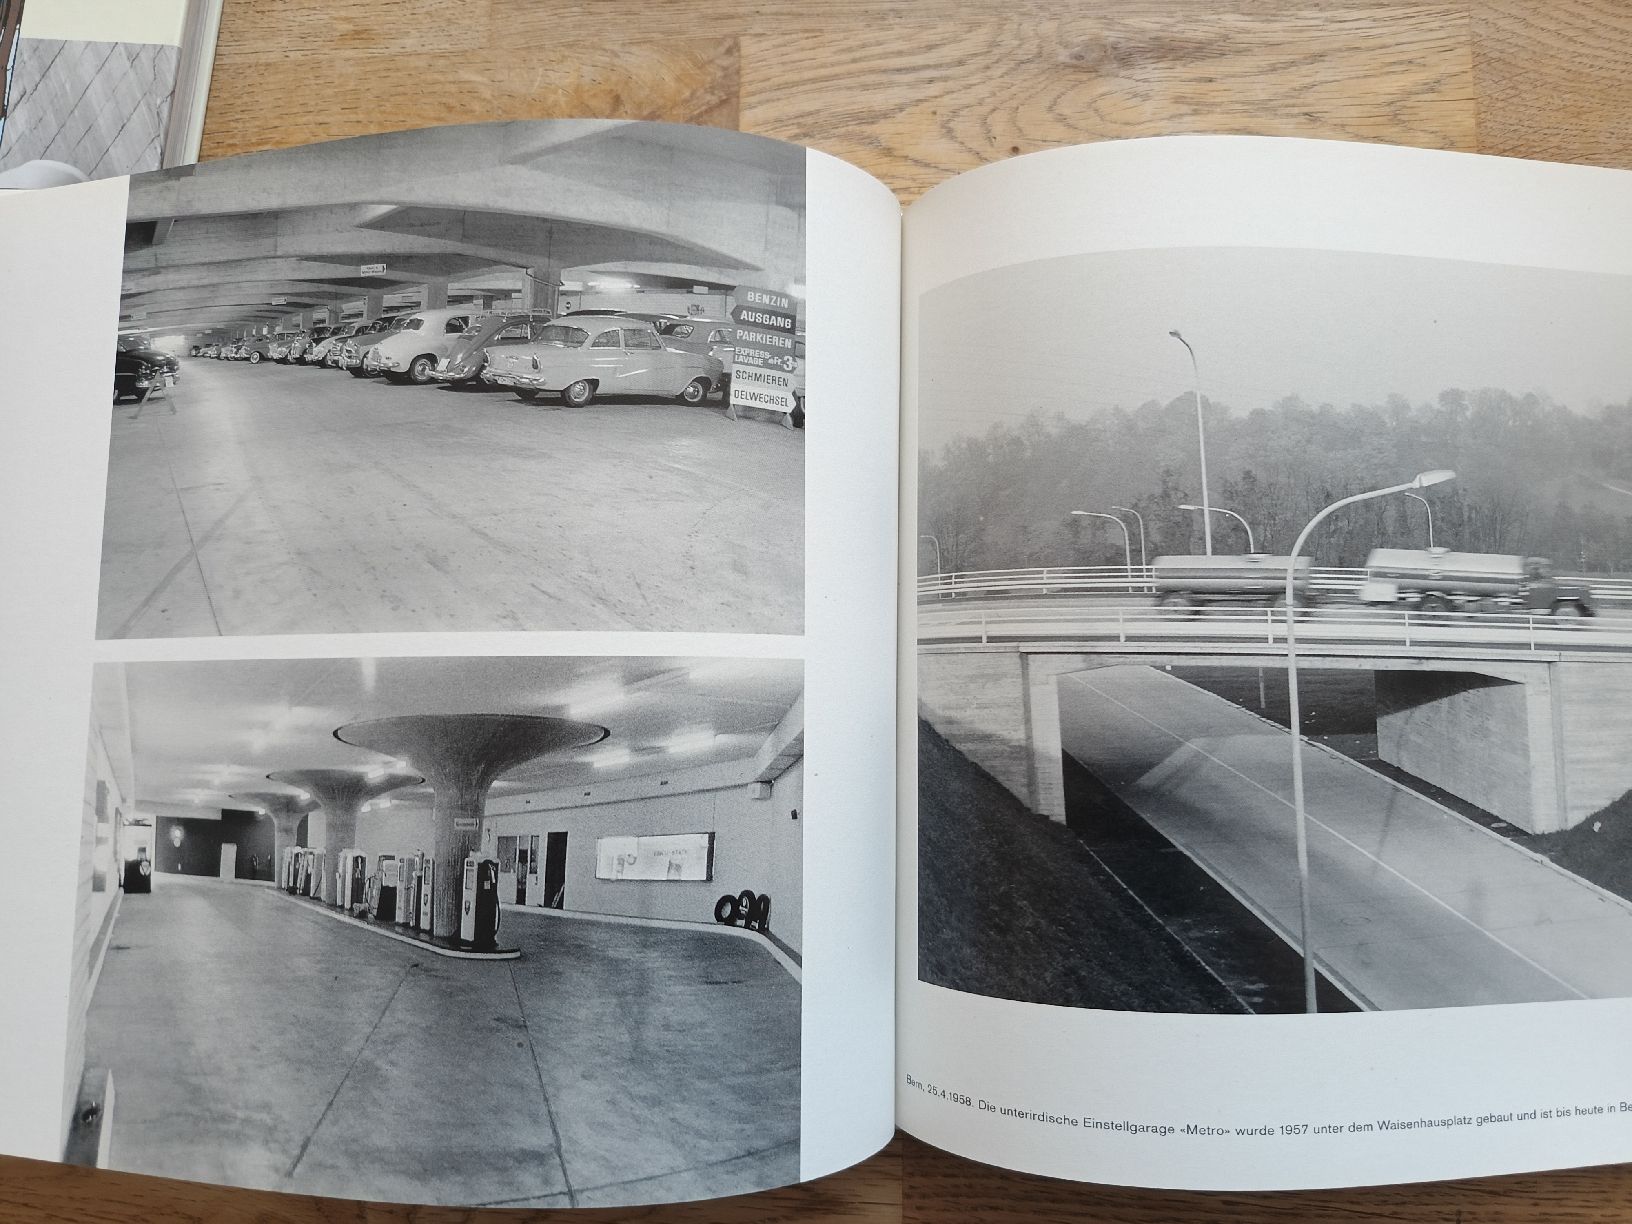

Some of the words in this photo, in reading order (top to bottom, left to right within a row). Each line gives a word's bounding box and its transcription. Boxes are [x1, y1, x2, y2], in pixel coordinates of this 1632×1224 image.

[747, 291, 789, 309] BENZIN
[740, 310, 792, 329] AUSGANG
[736, 329, 792, 349] PARKIEREN
[735, 355, 764, 366] LAVAGE
[735, 370, 789, 387] SCHMIEREN
[734, 389, 789, 407] OELWECHSEL
[906, 1073, 925, 1092] Bern,
[927, 1083, 975, 1108] 25.4.1958.
[978, 1099, 996, 1113] Die
[999, 1106, 1079, 1127] unterirdische
[1083, 1116, 1176, 1137] Einstellgarage
[1179, 1123, 1231, 1136] «Metro»
[1234, 1124, 1275, 1136] wurde
[1279, 1123, 1309, 1136] 1957
[1313, 1123, 1344, 1135] unter
[1347, 1121, 1374, 1133] dem
[1376, 1114, 1473, 1131] Waisenhausplatz
[1475, 1112, 1514, 1127] gebaut
[1516, 1109, 1537, 1121] und
[1540, 1108, 1553, 1119] ist
[1556, 1106, 1572, 1118] bis
[1574, 1105, 1604, 1116] heute
[1606, 1104, 1616, 1113] in
